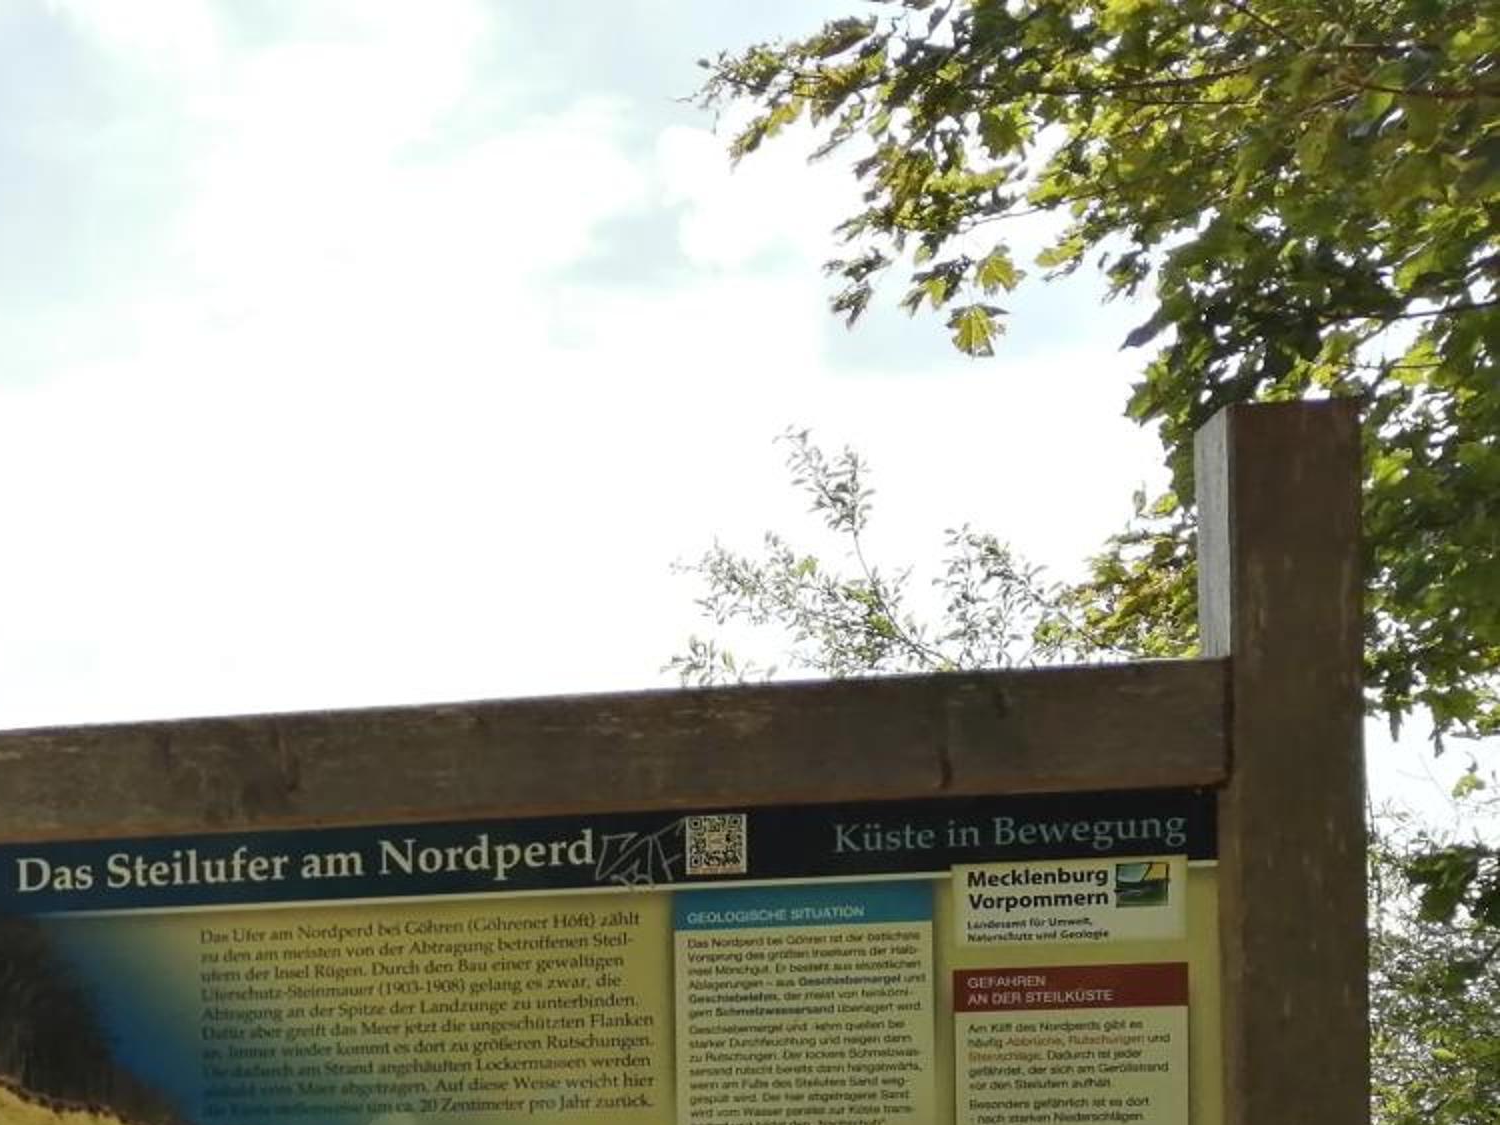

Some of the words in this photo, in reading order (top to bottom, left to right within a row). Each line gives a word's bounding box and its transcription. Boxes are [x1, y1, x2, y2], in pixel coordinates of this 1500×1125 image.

[835, 821, 936, 854] Küste
[947, 824, 980, 849] in
[994, 815, 1188, 852] Bewegung
[15, 855, 94, 892] Das
[106, 843, 294, 889] Steilufer
[300, 850, 364, 879] am
[378, 829, 597, 884] Nordperd
[966, 867, 1110, 888] Mecklenburg
[968, 890, 1110, 913] Vorpommern
[686, 908, 786, 923] GEOLOGISCHE
[790, 905, 864, 920] SITUATION
[1029, 916, 1045, 928] für
[199, 929, 229, 944] Das
[232, 927, 265, 942] Ufer
[269, 929, 293, 941] am
[297, 922, 373, 942] Nordperd
[377, 921, 401, 936] bei
[403, 918, 464, 935] Göhren
[552, 912, 595, 931] Höft)
[600, 910, 639, 926] zählt
[1035, 930, 1057, 941] und
[1060, 928, 1110, 942] Geologie
[200, 952, 219, 963] zu
[222, 948, 251, 962] den
[254, 950, 278, 961] am
[282, 944, 341, 960] meisten
[345, 946, 375, 957] von
[378, 941, 404, 956] der
[592, 932, 634, 947] Steil-
[244, 967, 269, 980] der
[274, 965, 309, 979] Insel
[314, 963, 367, 980] Rügen.
[371, 961, 420, 976] Durch
[423, 959, 453, 974] den
[457, 958, 487, 972] Bau
[491, 956, 530, 971] einer
[469, 976, 521, 994] gelang
[525, 979, 542, 990] es
[546, 977, 590, 992] zwar,
[595, 973, 621, 987] die
[966, 975, 1046, 989] GEFAHREN
[967, 994, 988, 1006] AN
[991, 992, 1021, 1005] DER
[1025, 987, 1113, 1003] STEILKÜSTE
[286, 1007, 305, 1018] an
[308, 1003, 333, 1017] der
[338, 1001, 385, 1019] Spitze
[389, 1000, 414, 1014] der
[512, 999, 531, 1010] zu
[285, 1023, 326, 1040] greift
[330, 1022, 357, 1036] das
[361, 1020, 400, 1035] Meer
[404, 1019, 437, 1036] jetzt
[440, 1018, 465, 1032] die
[590, 1012, 654, 1028] Flanken
[281, 1042, 331, 1056] wieder
[336, 1040, 390, 1055] kommt
[393, 1043, 410, 1053] es
[413, 1039, 445, 1053] dort
[450, 1041, 469, 1052] zu
[472, 1036, 542, 1054] größeren
